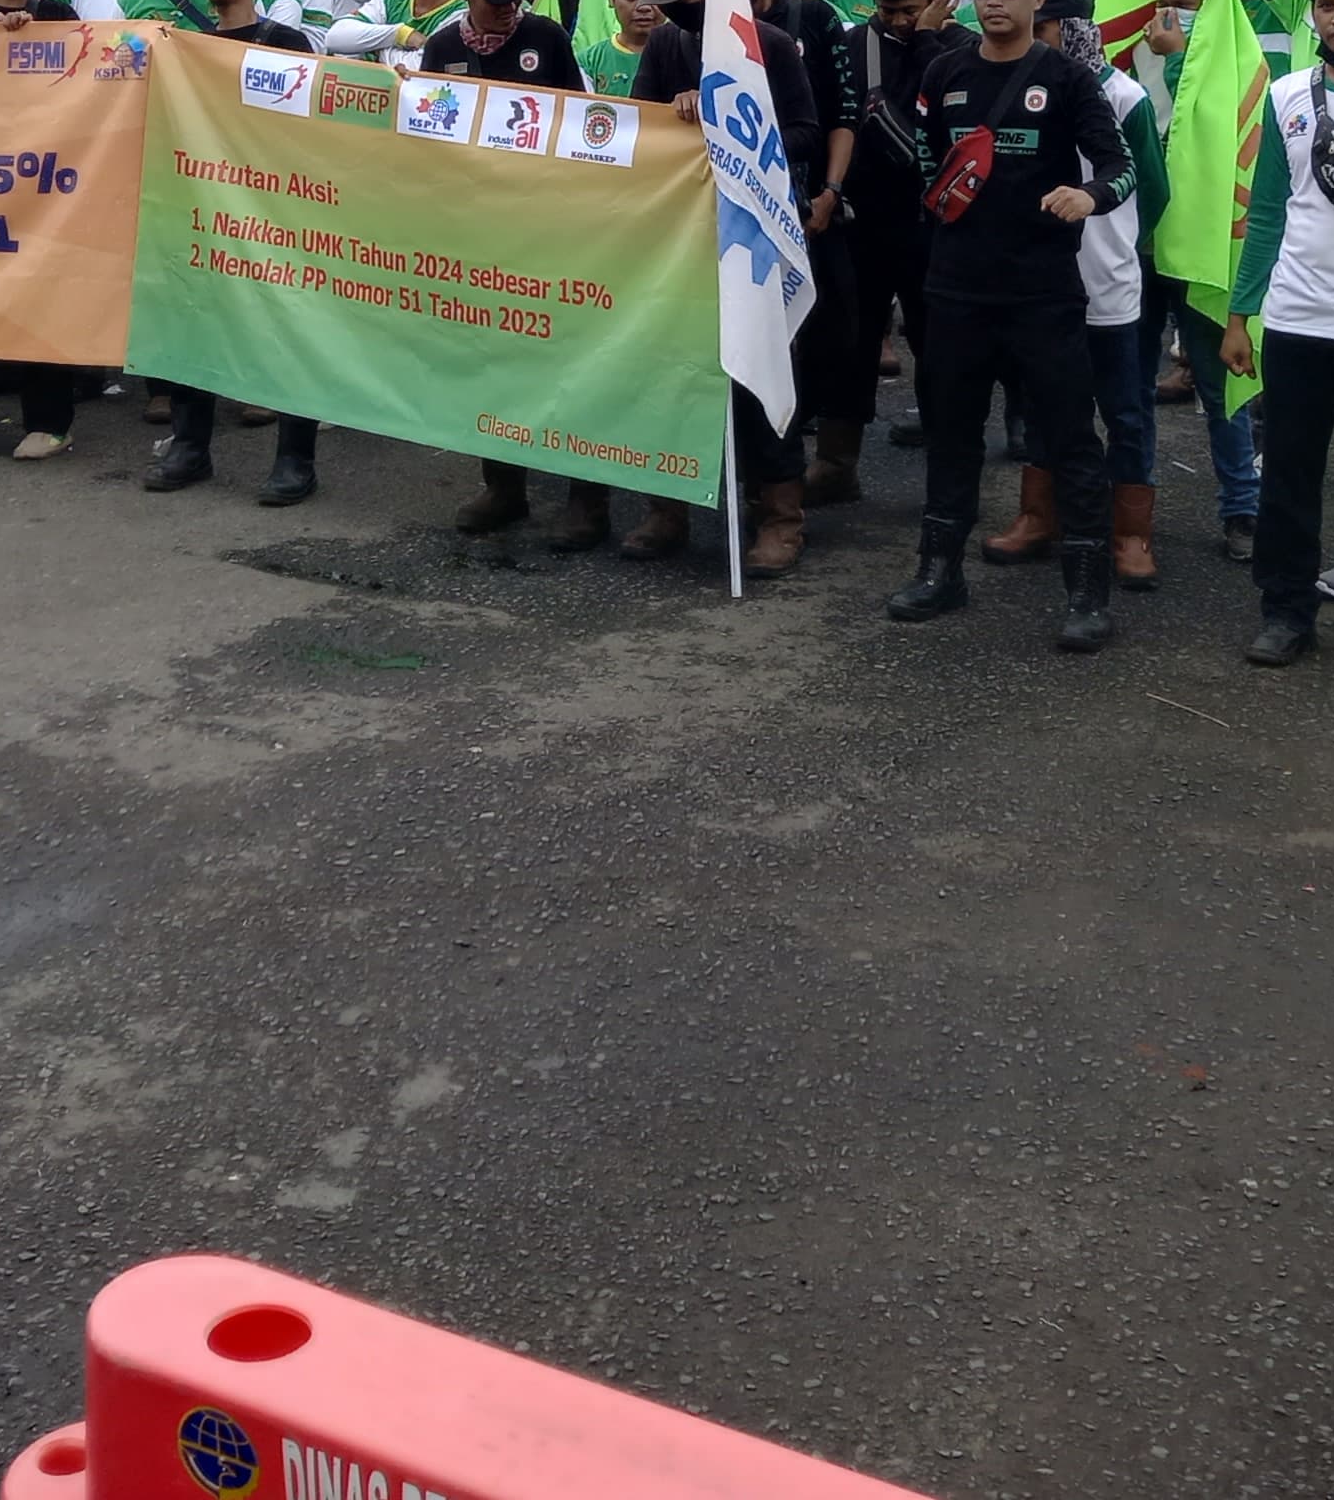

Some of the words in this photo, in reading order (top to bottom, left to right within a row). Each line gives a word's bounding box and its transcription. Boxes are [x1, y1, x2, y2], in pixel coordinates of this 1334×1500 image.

[8, 41, 65, 69] FSPMI
[245, 67, 287, 92] FSPMI
[408, 117, 437, 130] KSPI
[699, 70, 795, 207] KSP
[174, 149, 281, 195] Tuntutan
[286, 170, 340, 206] Aksi:
[571, 151, 616, 163] KOPASKEP
[744, 167, 780, 220] SERIKAT
[192, 207, 206, 234] 1.
[212, 210, 298, 250] Naikkan
[302, 226, 345, 260] UMK
[349, 238, 408, 274] Tahun
[413, 253, 464, 284] 2024
[469, 266, 552, 301] sebesar
[558, 277, 614, 311] 15%
[189, 243, 205, 270] 2.
[209, 250, 296, 287] Menolak
[301, 265, 327, 292] PP
[332, 277, 393, 310] nomor
[398, 283, 424, 314] 51
[428, 293, 492, 329] Tahun
[498, 307, 553, 340] 2023
[476, 412, 535, 450] Cilacap,
[541, 427, 562, 451] 16
[566, 432, 651, 471] November
[655, 449, 700, 480] 2023
